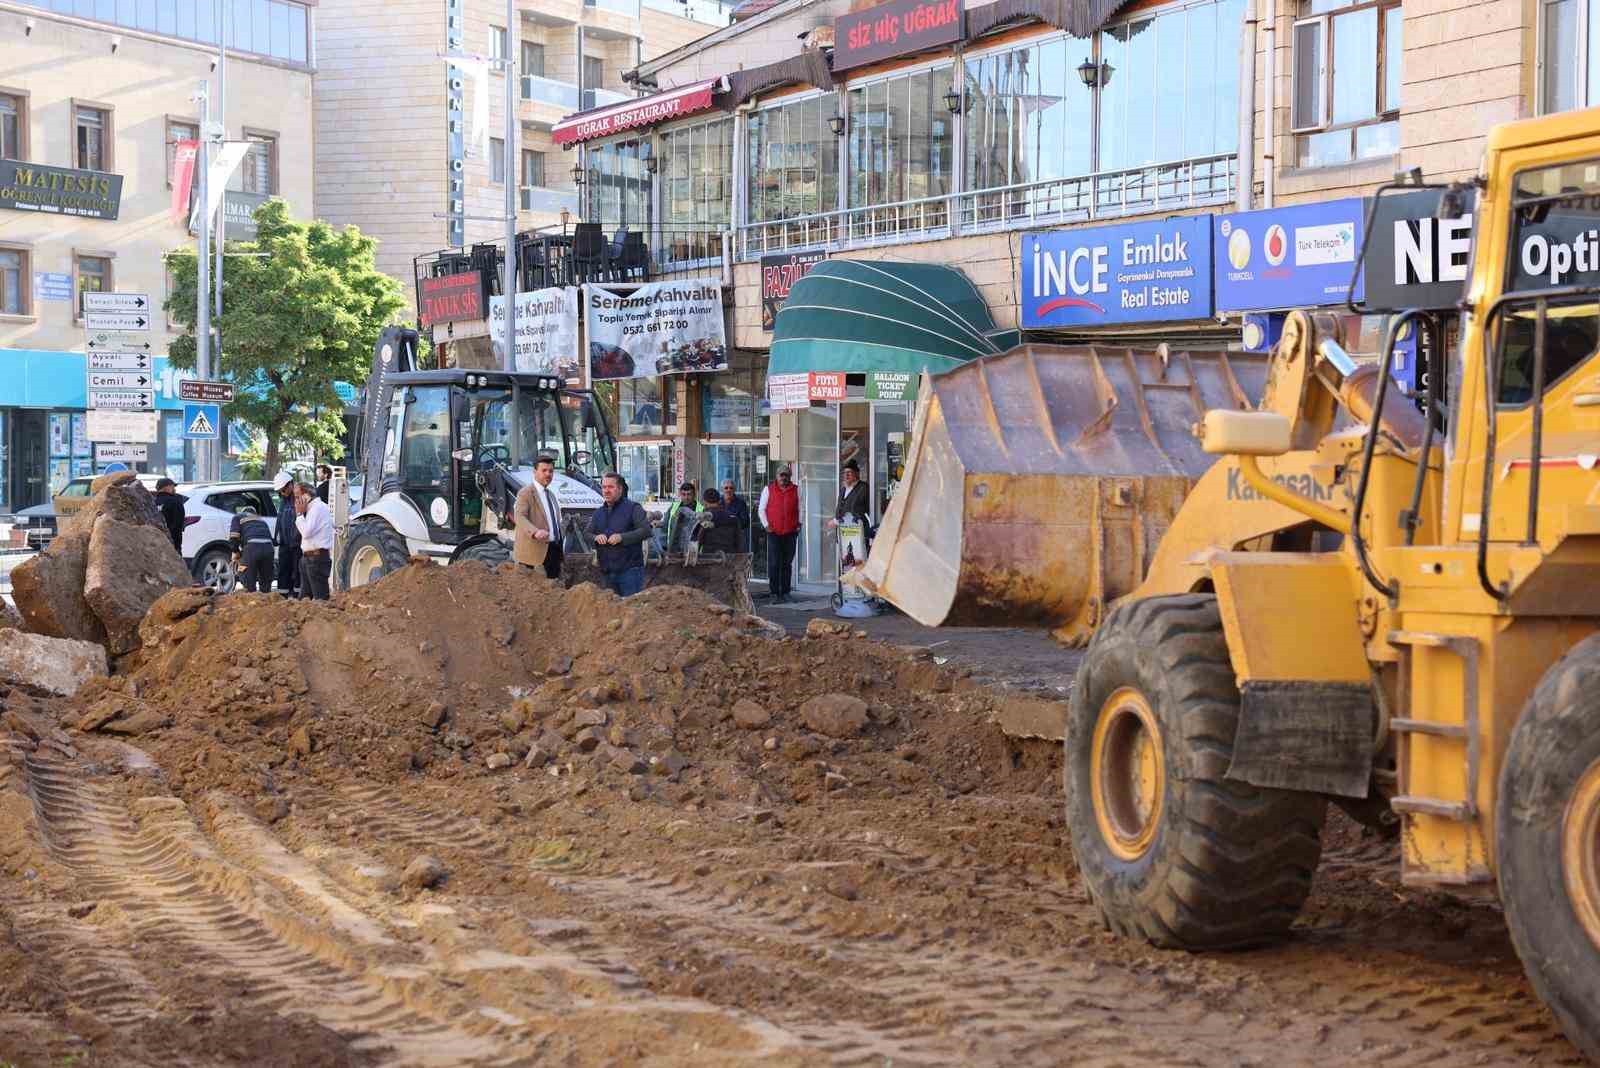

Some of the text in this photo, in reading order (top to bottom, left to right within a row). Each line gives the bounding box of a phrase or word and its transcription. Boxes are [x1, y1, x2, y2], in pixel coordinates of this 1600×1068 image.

[903, 1, 959, 33] UĞRAK
[613, 99, 681, 127] RESTAURANT
[1394, 213, 1600, 285] NE Opti
[1033, 231, 1188, 297] İNCE Emlak
[591, 286, 717, 311] Serpme Kahvaltı
[1121, 285, 1190, 309] Real Estate
[598, 313, 624, 325] Toplu
[92, 376, 125, 385] Cemil
[815, 374, 838, 386] FOTO
[874, 373, 909, 382] BALLOON
[877, 382, 906, 391] TICKET
[879, 391, 903, 399] POINT
